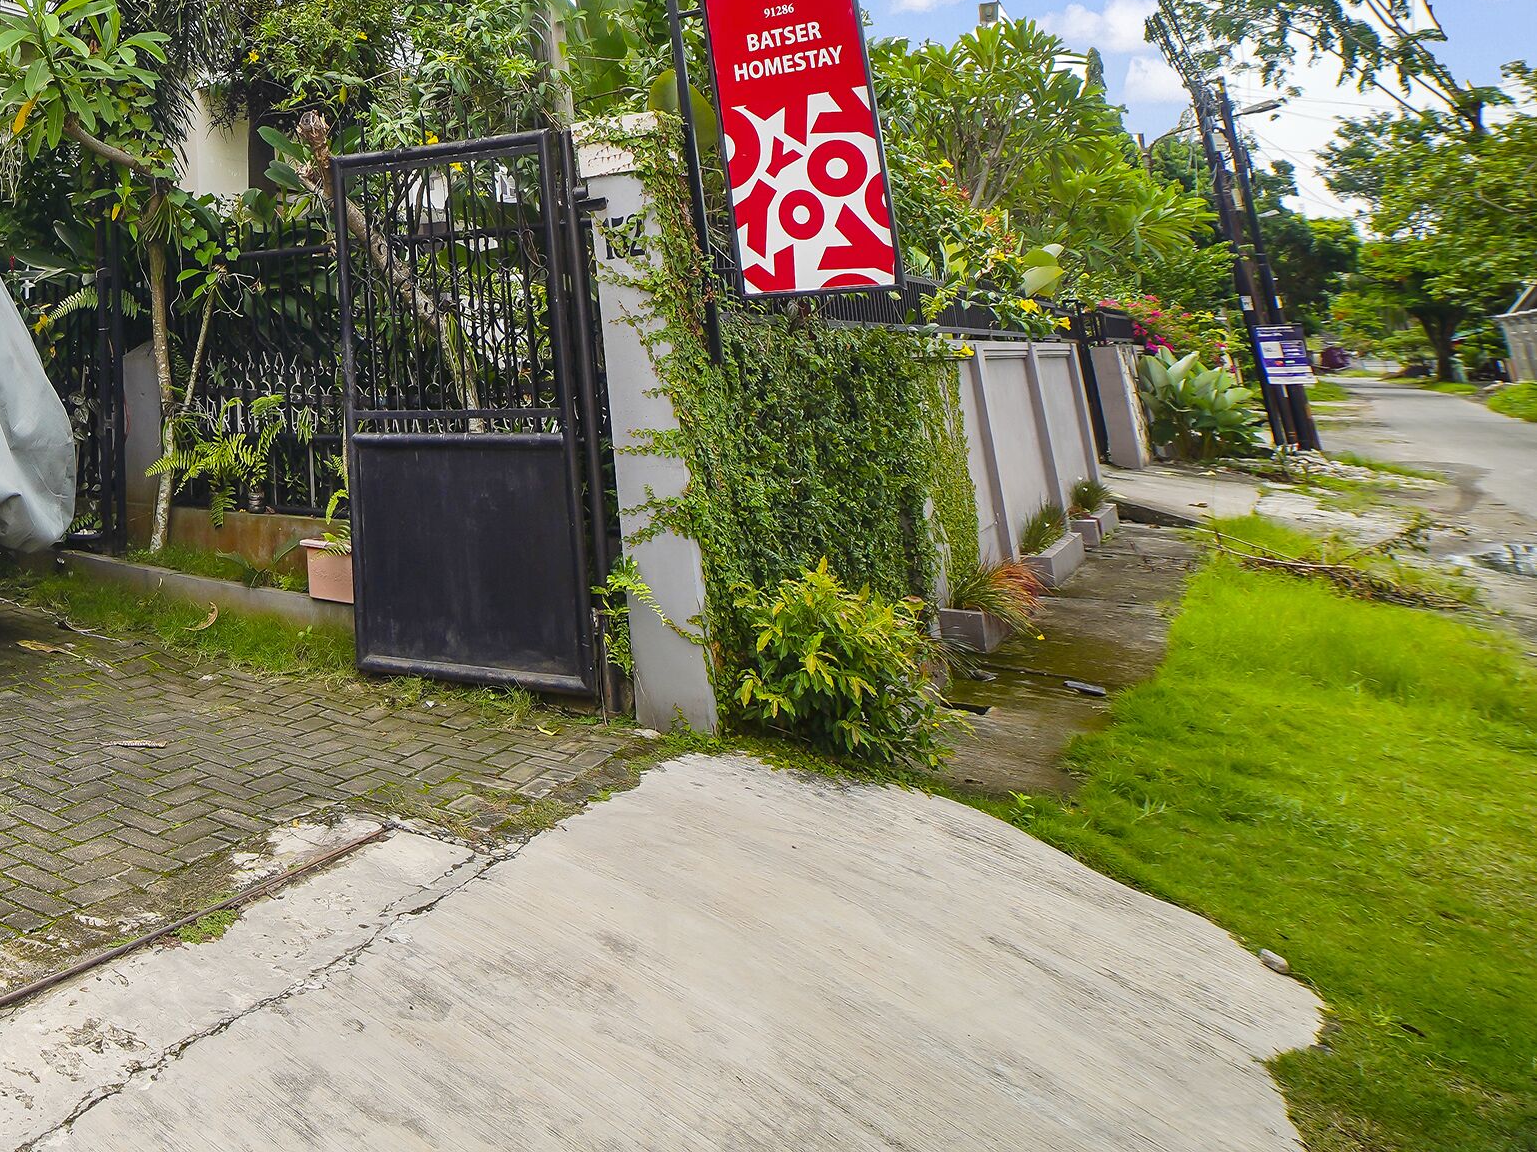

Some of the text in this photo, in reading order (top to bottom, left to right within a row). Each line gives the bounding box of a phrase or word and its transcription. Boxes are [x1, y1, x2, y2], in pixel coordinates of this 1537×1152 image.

[764, 3, 794, 18] 91286
[746, 22, 822, 51] BATSER
[734, 45, 843, 81] HOMESTAY
